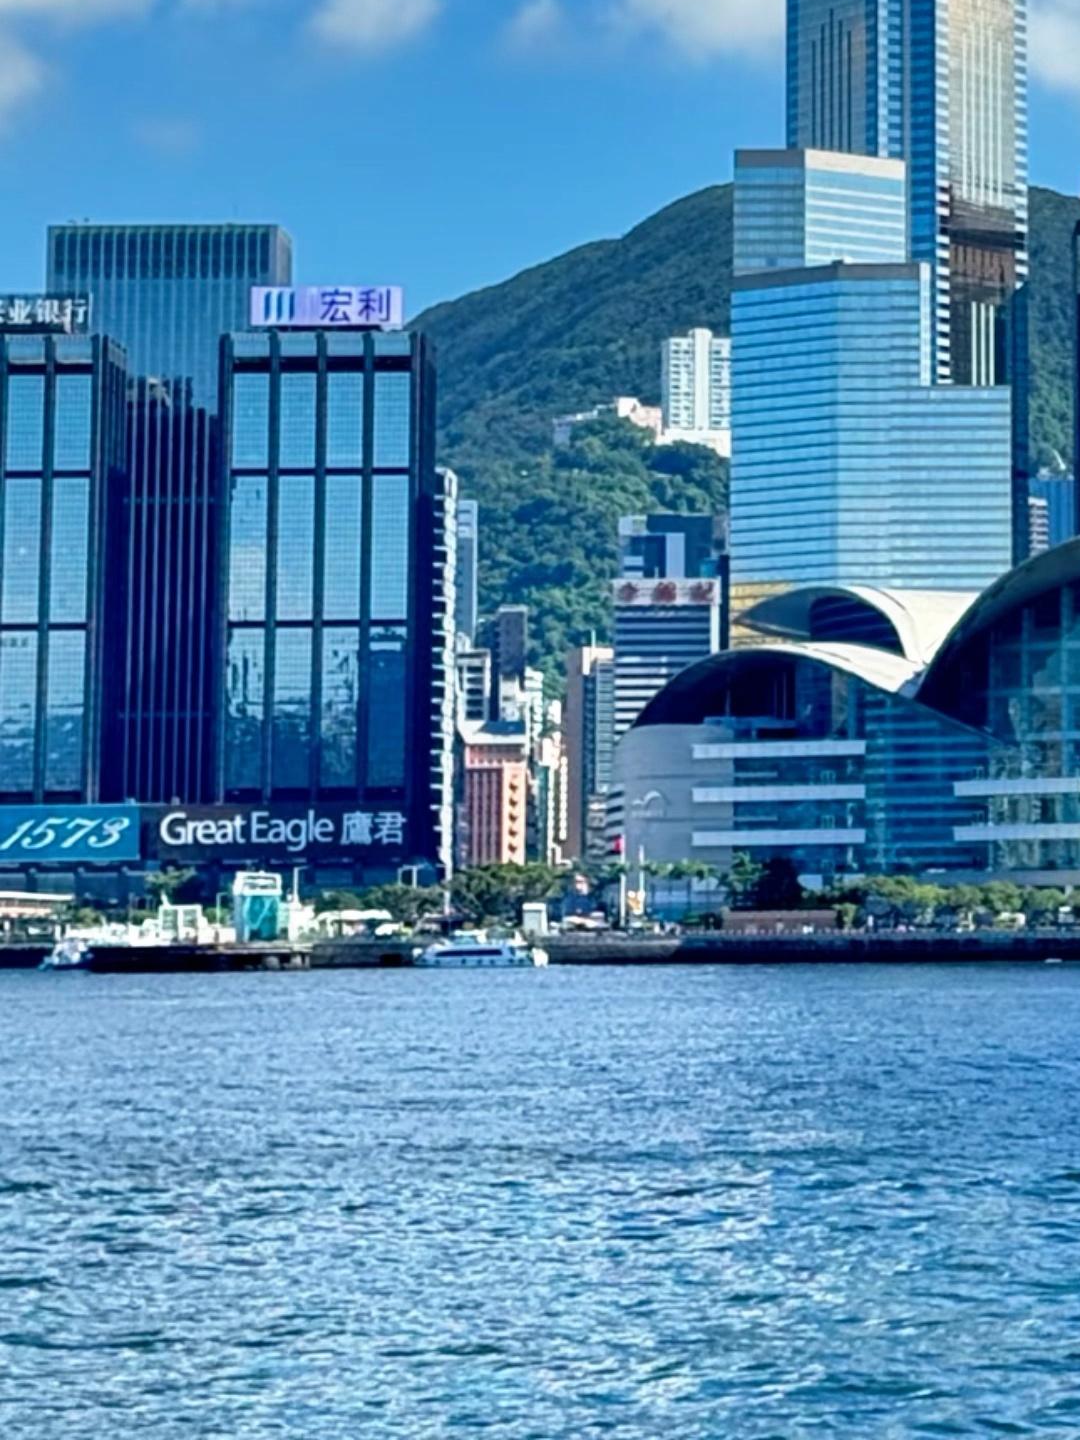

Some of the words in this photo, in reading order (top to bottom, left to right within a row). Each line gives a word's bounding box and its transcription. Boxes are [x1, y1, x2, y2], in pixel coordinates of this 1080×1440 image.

[0, 298, 87, 324] 业银行
[320, 288, 391, 322] 宏利
[0, 817, 131, 850] 1573
[159, 812, 246, 845] Great
[250, 810, 335, 852] Eagle
[340, 811, 407, 845] 鷹君
